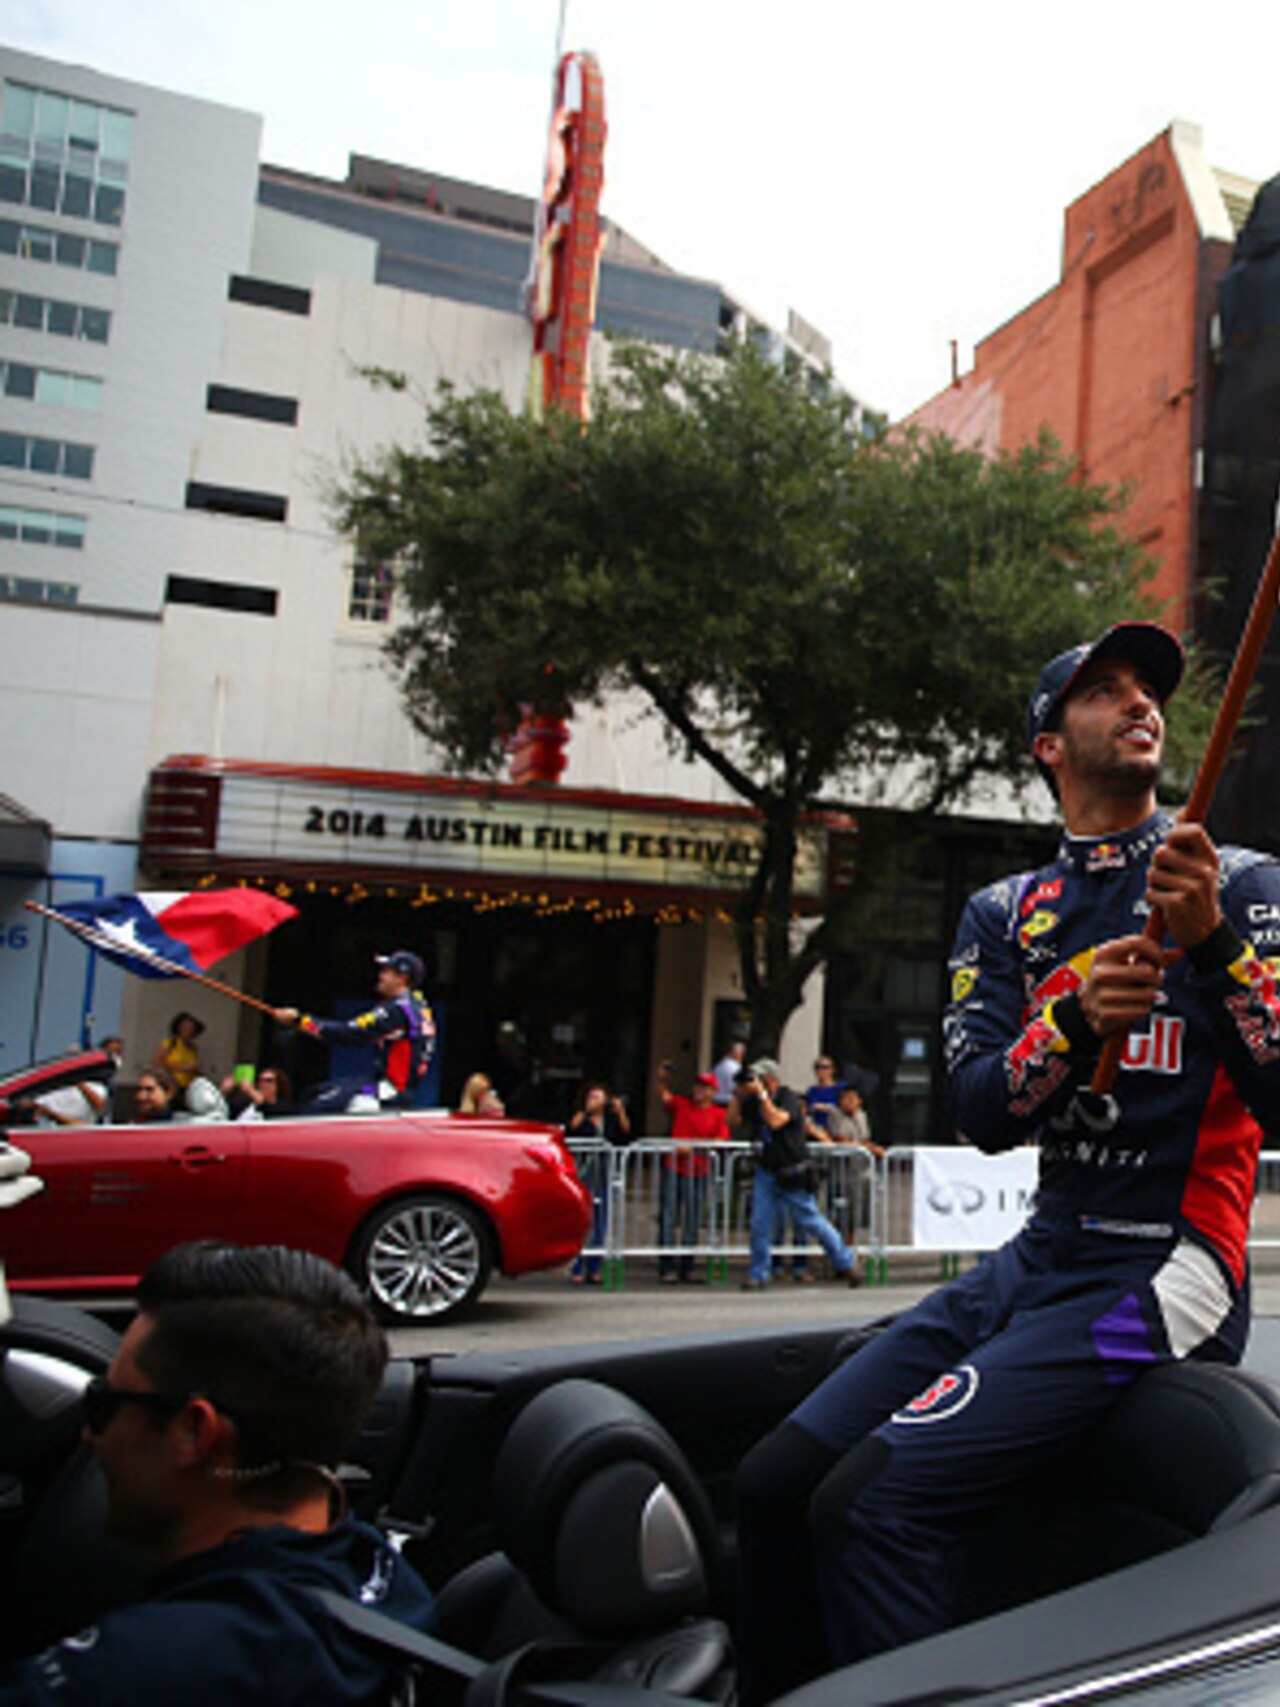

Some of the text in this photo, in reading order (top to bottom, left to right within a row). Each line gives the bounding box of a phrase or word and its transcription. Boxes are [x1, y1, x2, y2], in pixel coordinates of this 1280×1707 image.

[304, 806, 760, 867] 2014 AUSTIN FILM FESTIVAL
[0, 924, 28, 950] 6
[1119, 1014, 1185, 1074] ull
